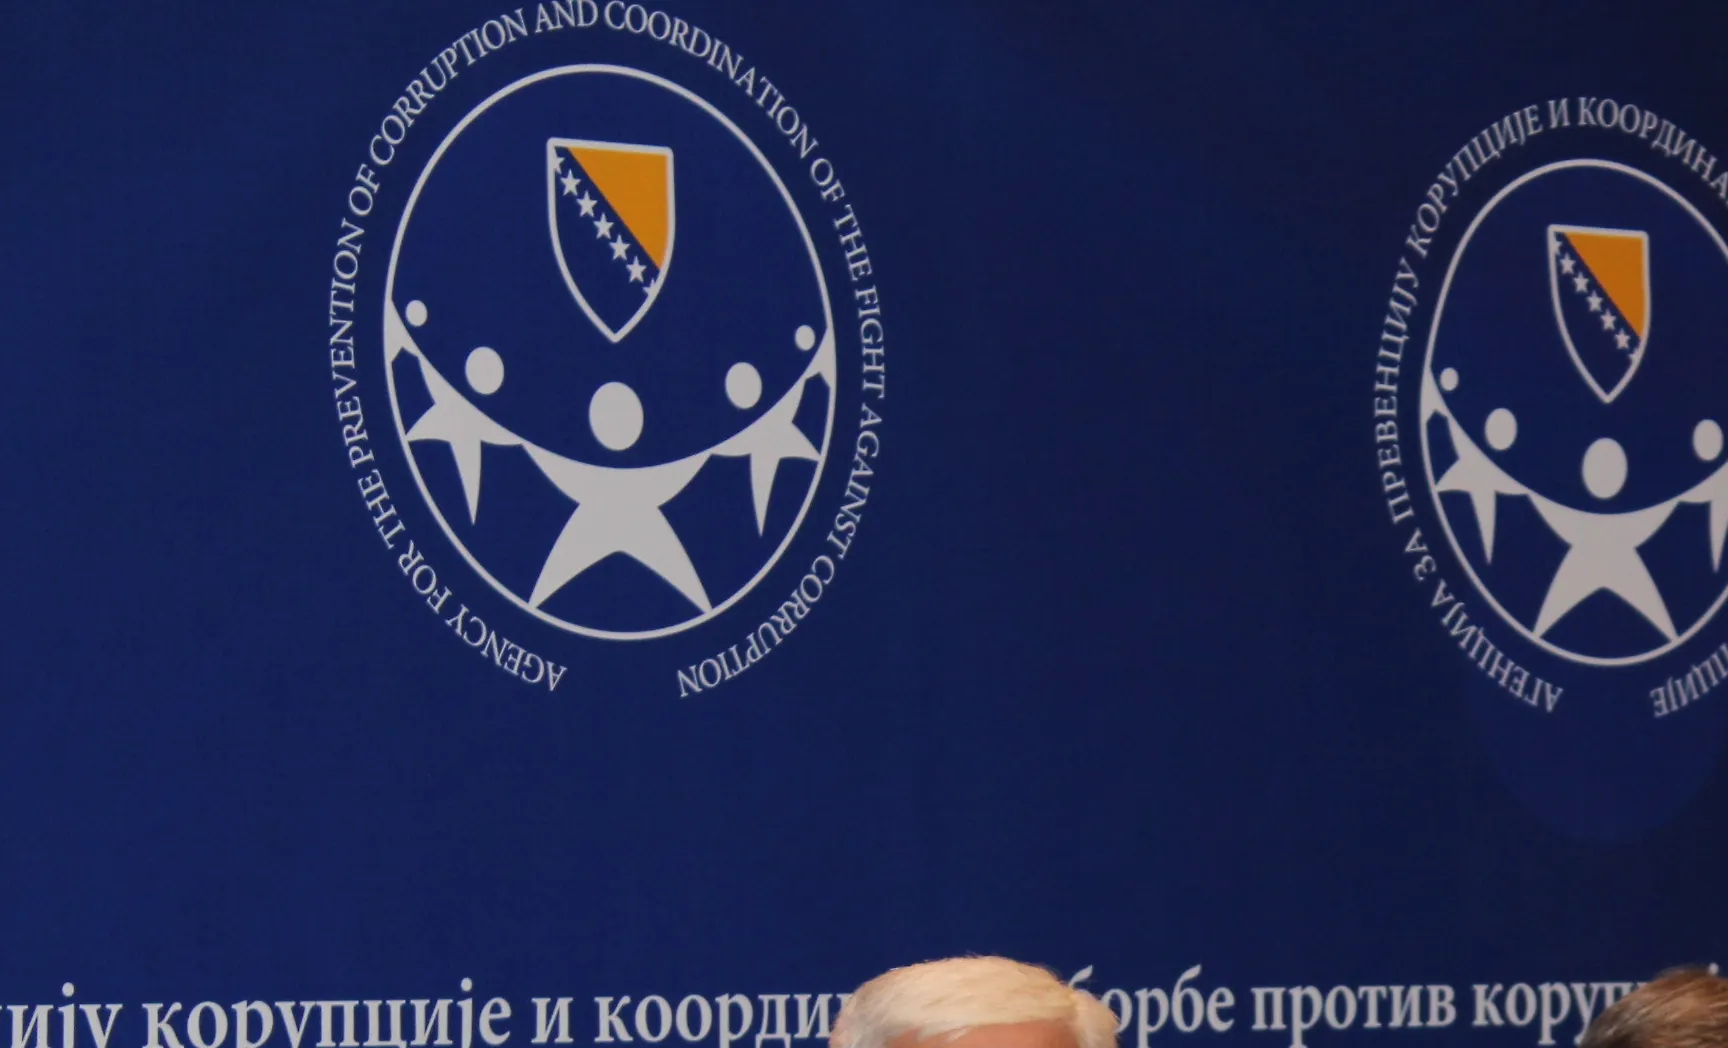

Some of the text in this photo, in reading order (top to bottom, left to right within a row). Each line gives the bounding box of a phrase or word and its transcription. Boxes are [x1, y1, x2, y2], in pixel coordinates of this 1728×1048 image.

[1405, 103, 1544, 258] КОРУПЦИЈЕ
[1547, 96, 1571, 130] И
[328, 0, 886, 699] AGENCY FOR THE PREVENTION OF CORRUPTION AND COORDINATION OF THE FIGHT AGAINST CORRUPTION
[1373, 256, 1420, 525] ПРЕВЕНЦИЈУ
[1403, 527, 1434, 578] ЗА
[1430, 578, 1564, 713] АГЕНЦИЈА
[531, 996, 575, 1045] и
